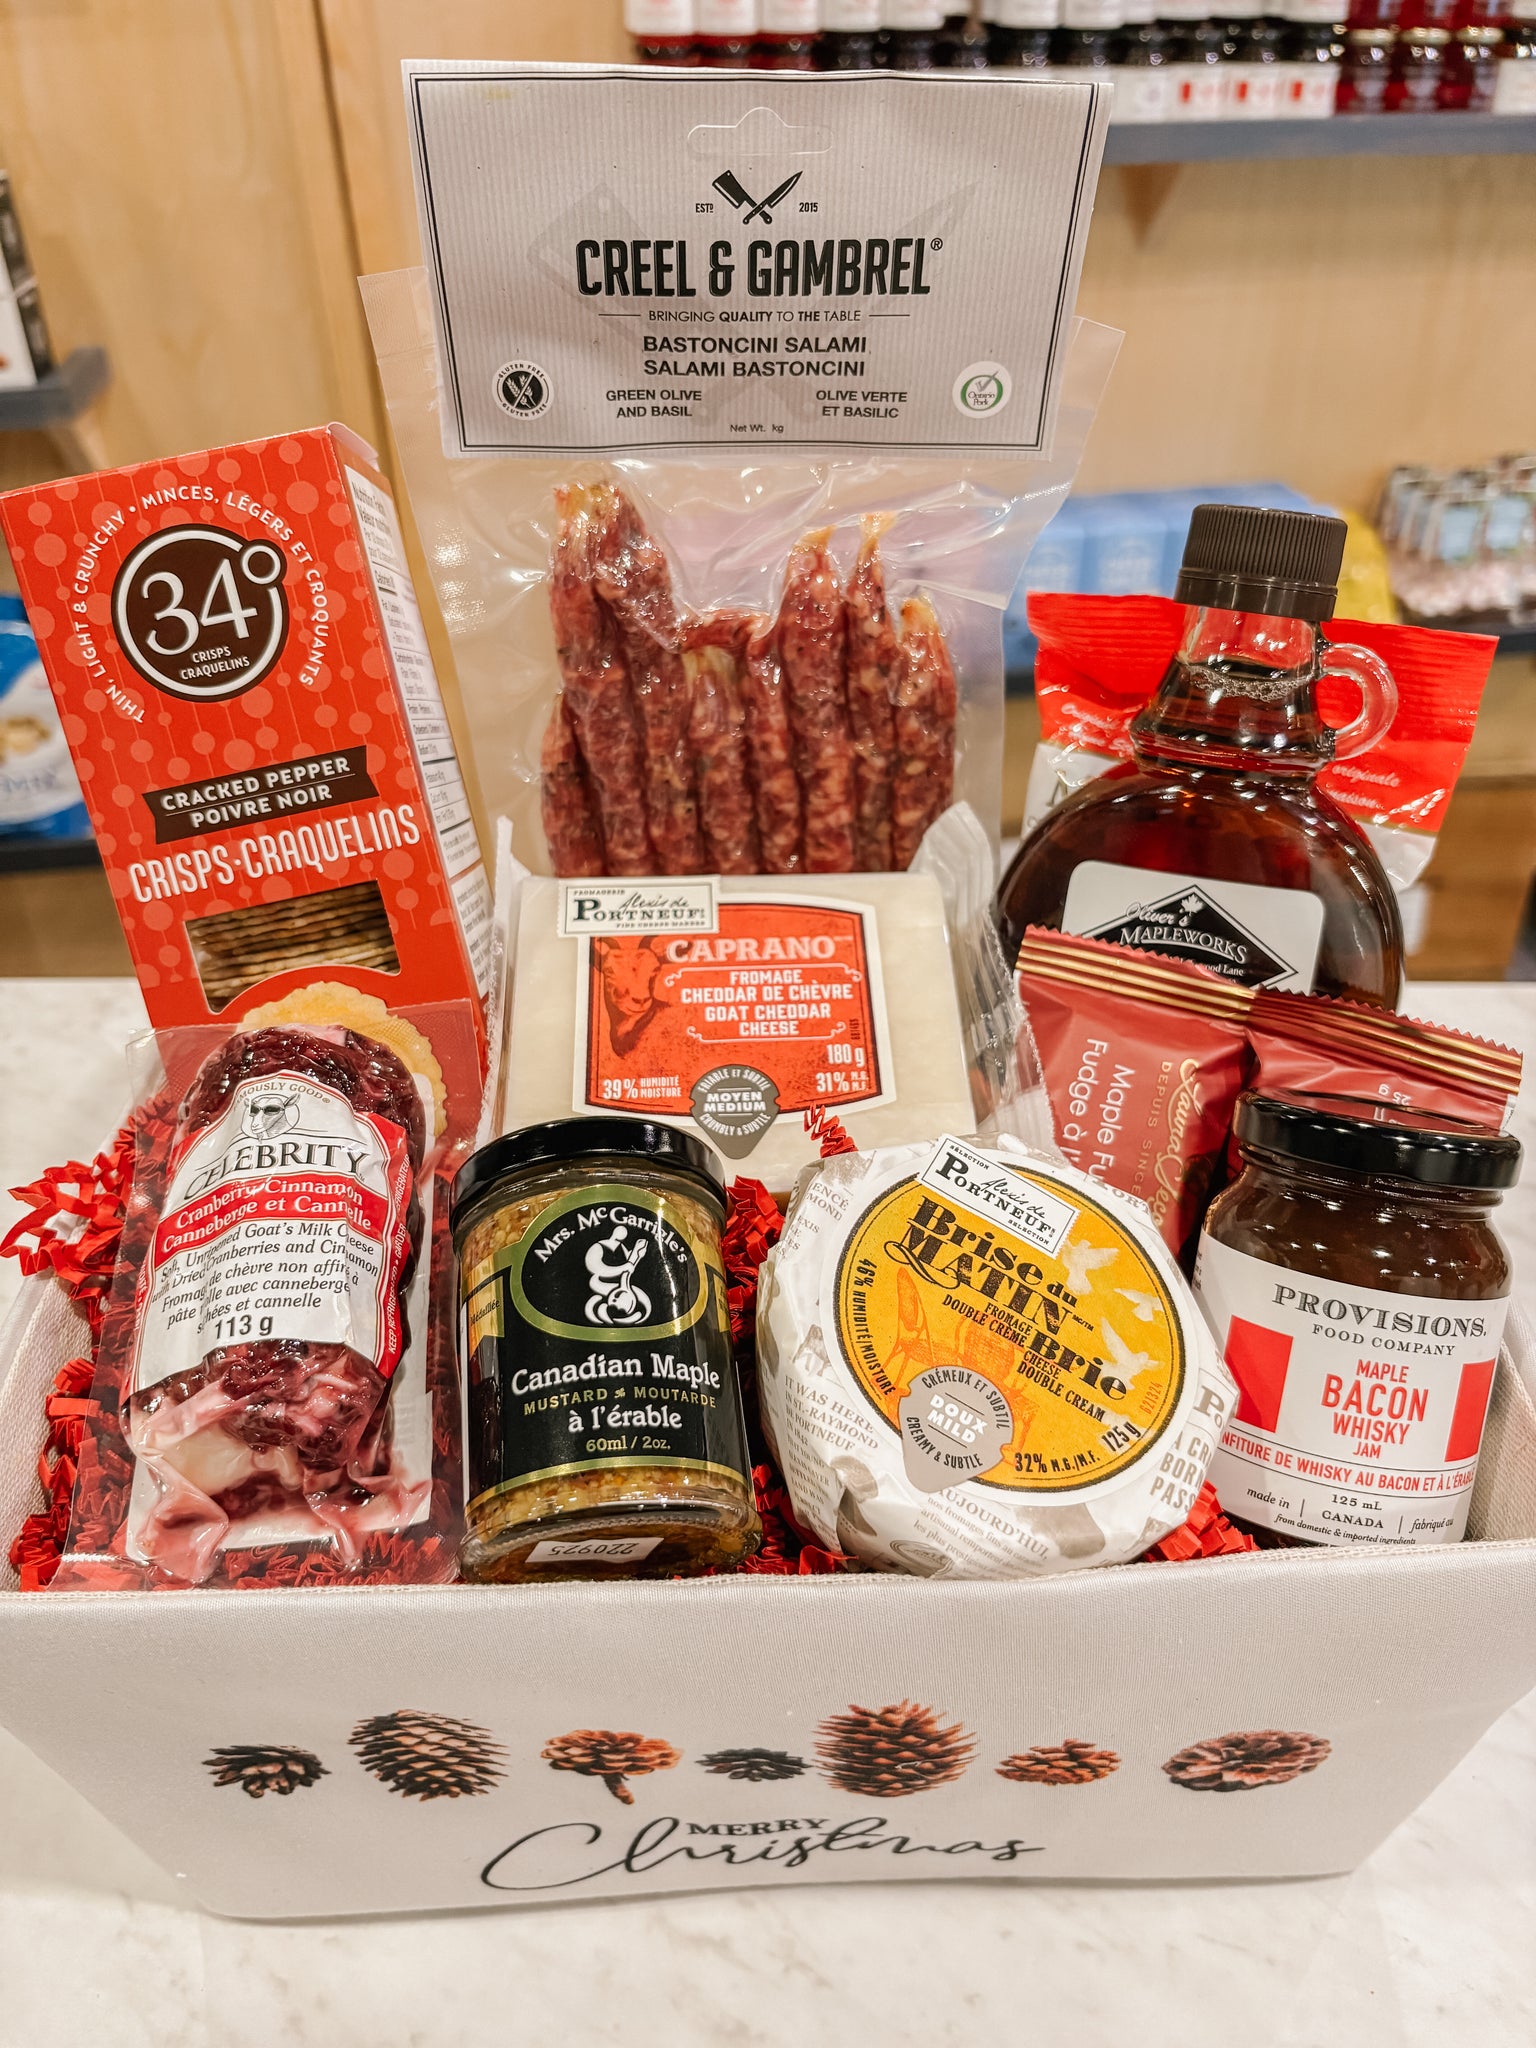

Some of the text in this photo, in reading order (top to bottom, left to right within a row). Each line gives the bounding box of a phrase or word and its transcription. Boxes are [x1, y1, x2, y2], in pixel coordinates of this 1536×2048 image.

[799, 202, 819, 213] 2015
[575, 240, 697, 297] CREEL
[709, 240, 735, 297] &
[649, 310, 861, 323] BRINGING QUALITY TO THE TABLE
[643, 335, 867, 354] BASTONCINI SALAMI
[643, 359, 865, 377] SALAMI BASTONCINI
[606, 389, 702, 402] GREEN OLIVE
[815, 390, 908, 402] OLIVE VERTE
[616, 405, 693, 419] AND BASIL
[822, 406, 899, 418] ET BASILIC
[729, 424, 784, 434] Net Wt. kg
[141, 485, 220, 510] MINCES,
[226, 491, 295, 541] LÉGERS
[74, 510, 126, 595] CRUNCHY
[290, 541, 314, 565] ET
[74, 602, 88, 613] &
[299, 568, 330, 686] CROQUANTS
[74, 621, 107, 678] LIGHT
[192, 646, 232, 664] CRISPS
[180, 656, 250, 680] CRAQUELINS
[106, 678, 146, 724] THIN,
[160, 757, 351, 812] CRACKED PEPPER
[191, 784, 333, 829] POIVRE NOIR
[666, 936, 836, 964] CAPRANO
[1119, 926, 1248, 965] MAPLEWORKS
[730, 969, 802, 986] FROMAGE
[1223, 964, 1244, 976] Lane
[681, 979, 853, 1004] CHEDDAR DE CHÈVRE
[704, 1003, 831, 1022] GOAT CHEDDAR
[739, 1020, 800, 1036] CHEESE
[827, 1044, 864, 1068] 180 g
[603, 1075, 680, 1100] 39% HUMIDITÉ
[640, 1086, 682, 1098] MOISTURE
[706, 1091, 763, 1102] MOYEN
[815, 1072, 850, 1093] 31%
[1063, 1038, 1110, 1141] Fudge à
[703, 1101, 767, 1112] MEDIUM
[1096, 1063, 1136, 1145] Maple
[743, 1112, 772, 1135] SUBTLE
[1130, 1061, 1174, 1194] DEPUIS SINCE
[184, 1141, 371, 1201] CELEBRITY
[176, 1179, 363, 1229] Cranberry Cinnamon
[162, 1195, 372, 1254] Canneberge et Cannelle
[245, 1222, 294, 1239] Goat's
[298, 1222, 333, 1237] Milk
[534, 1227, 576, 1264] Mrs.
[906, 1195, 1079, 1308] Brise du
[172, 1265, 207, 1289] Dried
[285, 1239, 315, 1254] and
[208, 1261, 359, 1287] de chèvre non à
[854, 1258, 878, 1290] 46%
[883, 1221, 1073, 1336] MATIN
[235, 1292, 322, 1311] et cannelle
[387, 1223, 407, 1354] KEEP GARDER
[167, 1280, 259, 1330] pâte avec
[941, 1293, 988, 1327] DOUBLE
[984, 1302, 1034, 1337] FROMAGE
[214, 1315, 274, 1340] 113 g
[1312, 1323, 1456, 1357] FOOD COMPANY
[511, 1352, 721, 1396] Canadian Maple
[1023, 1350, 1063, 1379] CHEESE
[1027, 1329, 1128, 1401] Brie
[1355, 1358, 1410, 1385] MAPLE
[523, 1386, 717, 1416] MUSTARD MOUTARDE
[921, 1367, 1011, 1430] CRÉMEUX ET SUBTIL
[1016, 1361, 1106, 1423] DOUBLE CREAM
[1320, 1373, 1430, 1423] BACON
[567, 1405, 683, 1433] à l'érable
[796, 1383, 830, 1407] WAS
[830, 1401, 876, 1435] HERE
[929, 1394, 989, 1436] DOUX
[794, 1413, 856, 1452] PORTNEUF
[926, 1409, 977, 1445] MILD
[1101, 1421, 1143, 1453] 125 g
[1331, 1411, 1411, 1446] WHISKY
[585, 1436, 671, 1453] 60ml 2oz.
[906, 1415, 984, 1470] CREAMY SUBTLE
[1352, 1444, 1382, 1460] JAM
[1014, 1452, 1048, 1474] 32%
[1274, 1449, 1292, 1469] DE
[1297, 1456, 1352, 1484] WHISKY
[1354, 1471, 1375, 1488] AU
[1377, 1475, 1420, 1492] BACON
[1422, 1476, 1436, 1491] ET
[1436, 1472, 1444, 1491] À
[1246, 1487, 1290, 1509] made in
[1331, 1494, 1383, 1511] 125 mL
[1273, 1512, 1416, 1546] from domestic & imported ingredients
[1321, 1510, 1385, 1529] CANADA
[1408, 1514, 1447, 1534] fabriqué
[686, 1818, 831, 1837] MERRY
[480, 1817, 1048, 1890] Christmas
